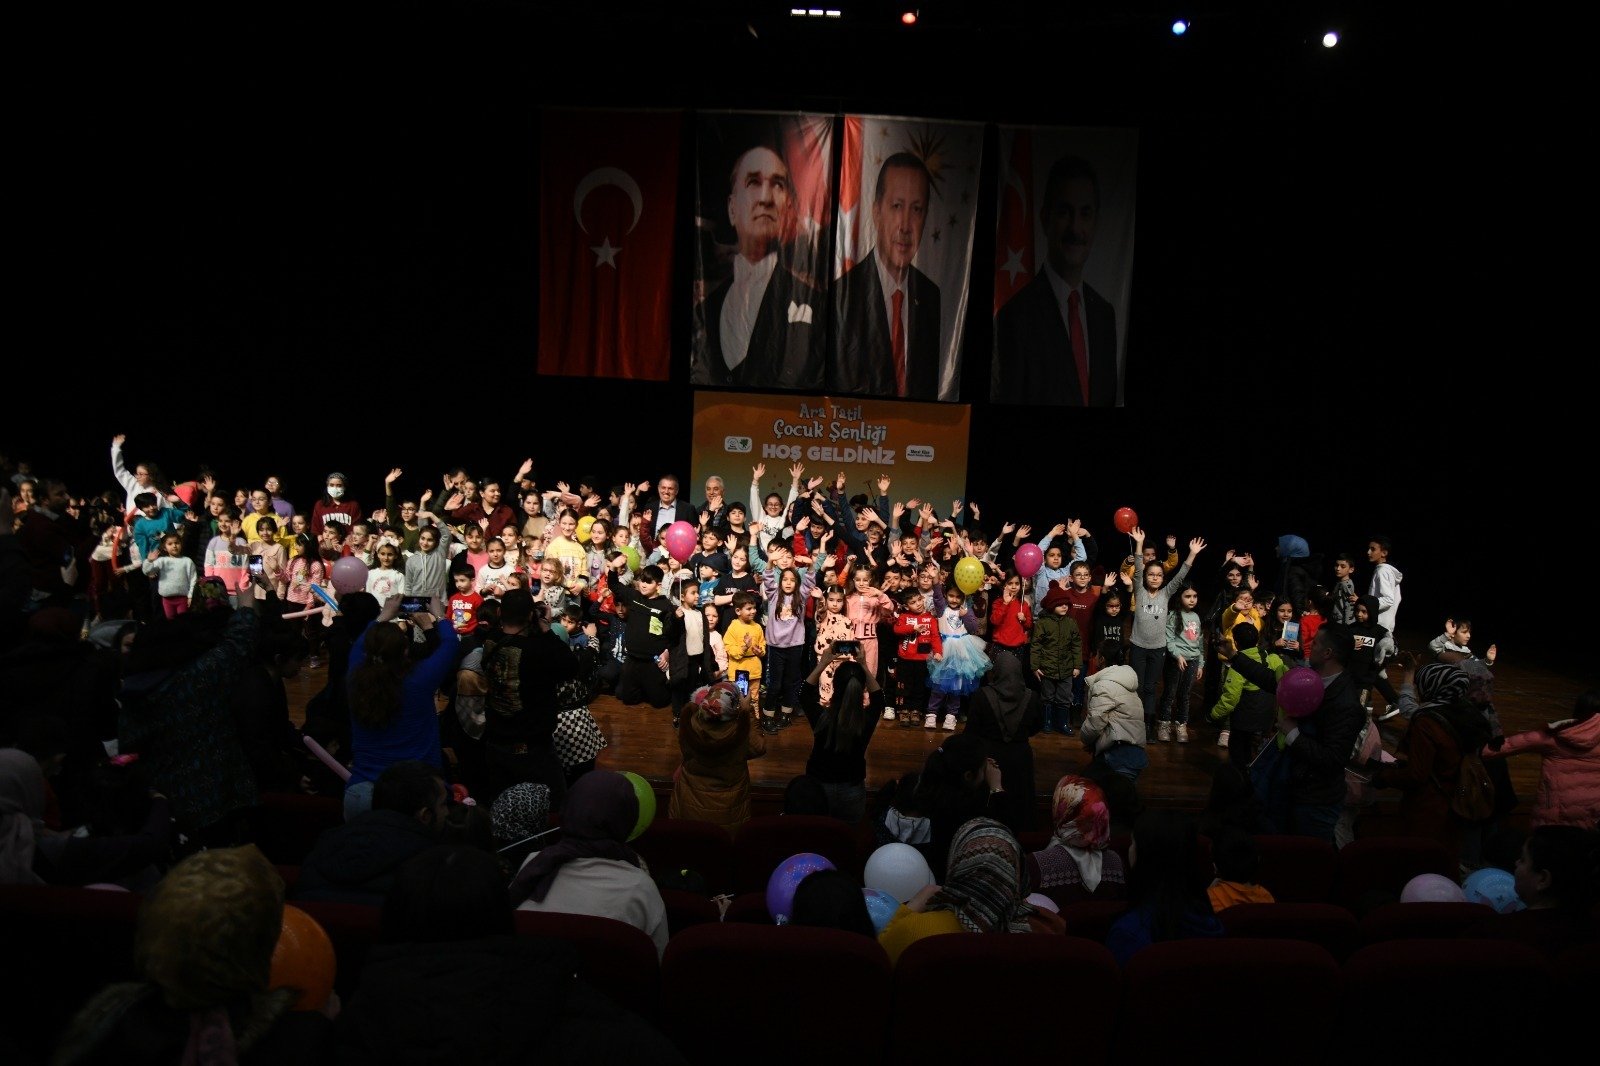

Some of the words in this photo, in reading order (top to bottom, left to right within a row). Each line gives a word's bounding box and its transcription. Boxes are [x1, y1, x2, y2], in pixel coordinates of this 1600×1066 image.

[800, 403, 826, 419] Ara
[830, 405, 862, 421] Tatil
[773, 419, 823, 439] Çocuk
[829, 421, 887, 446] Şenliği
[762, 443, 802, 462] HOŞ
[806, 445, 895, 465] GELDİNİZ
